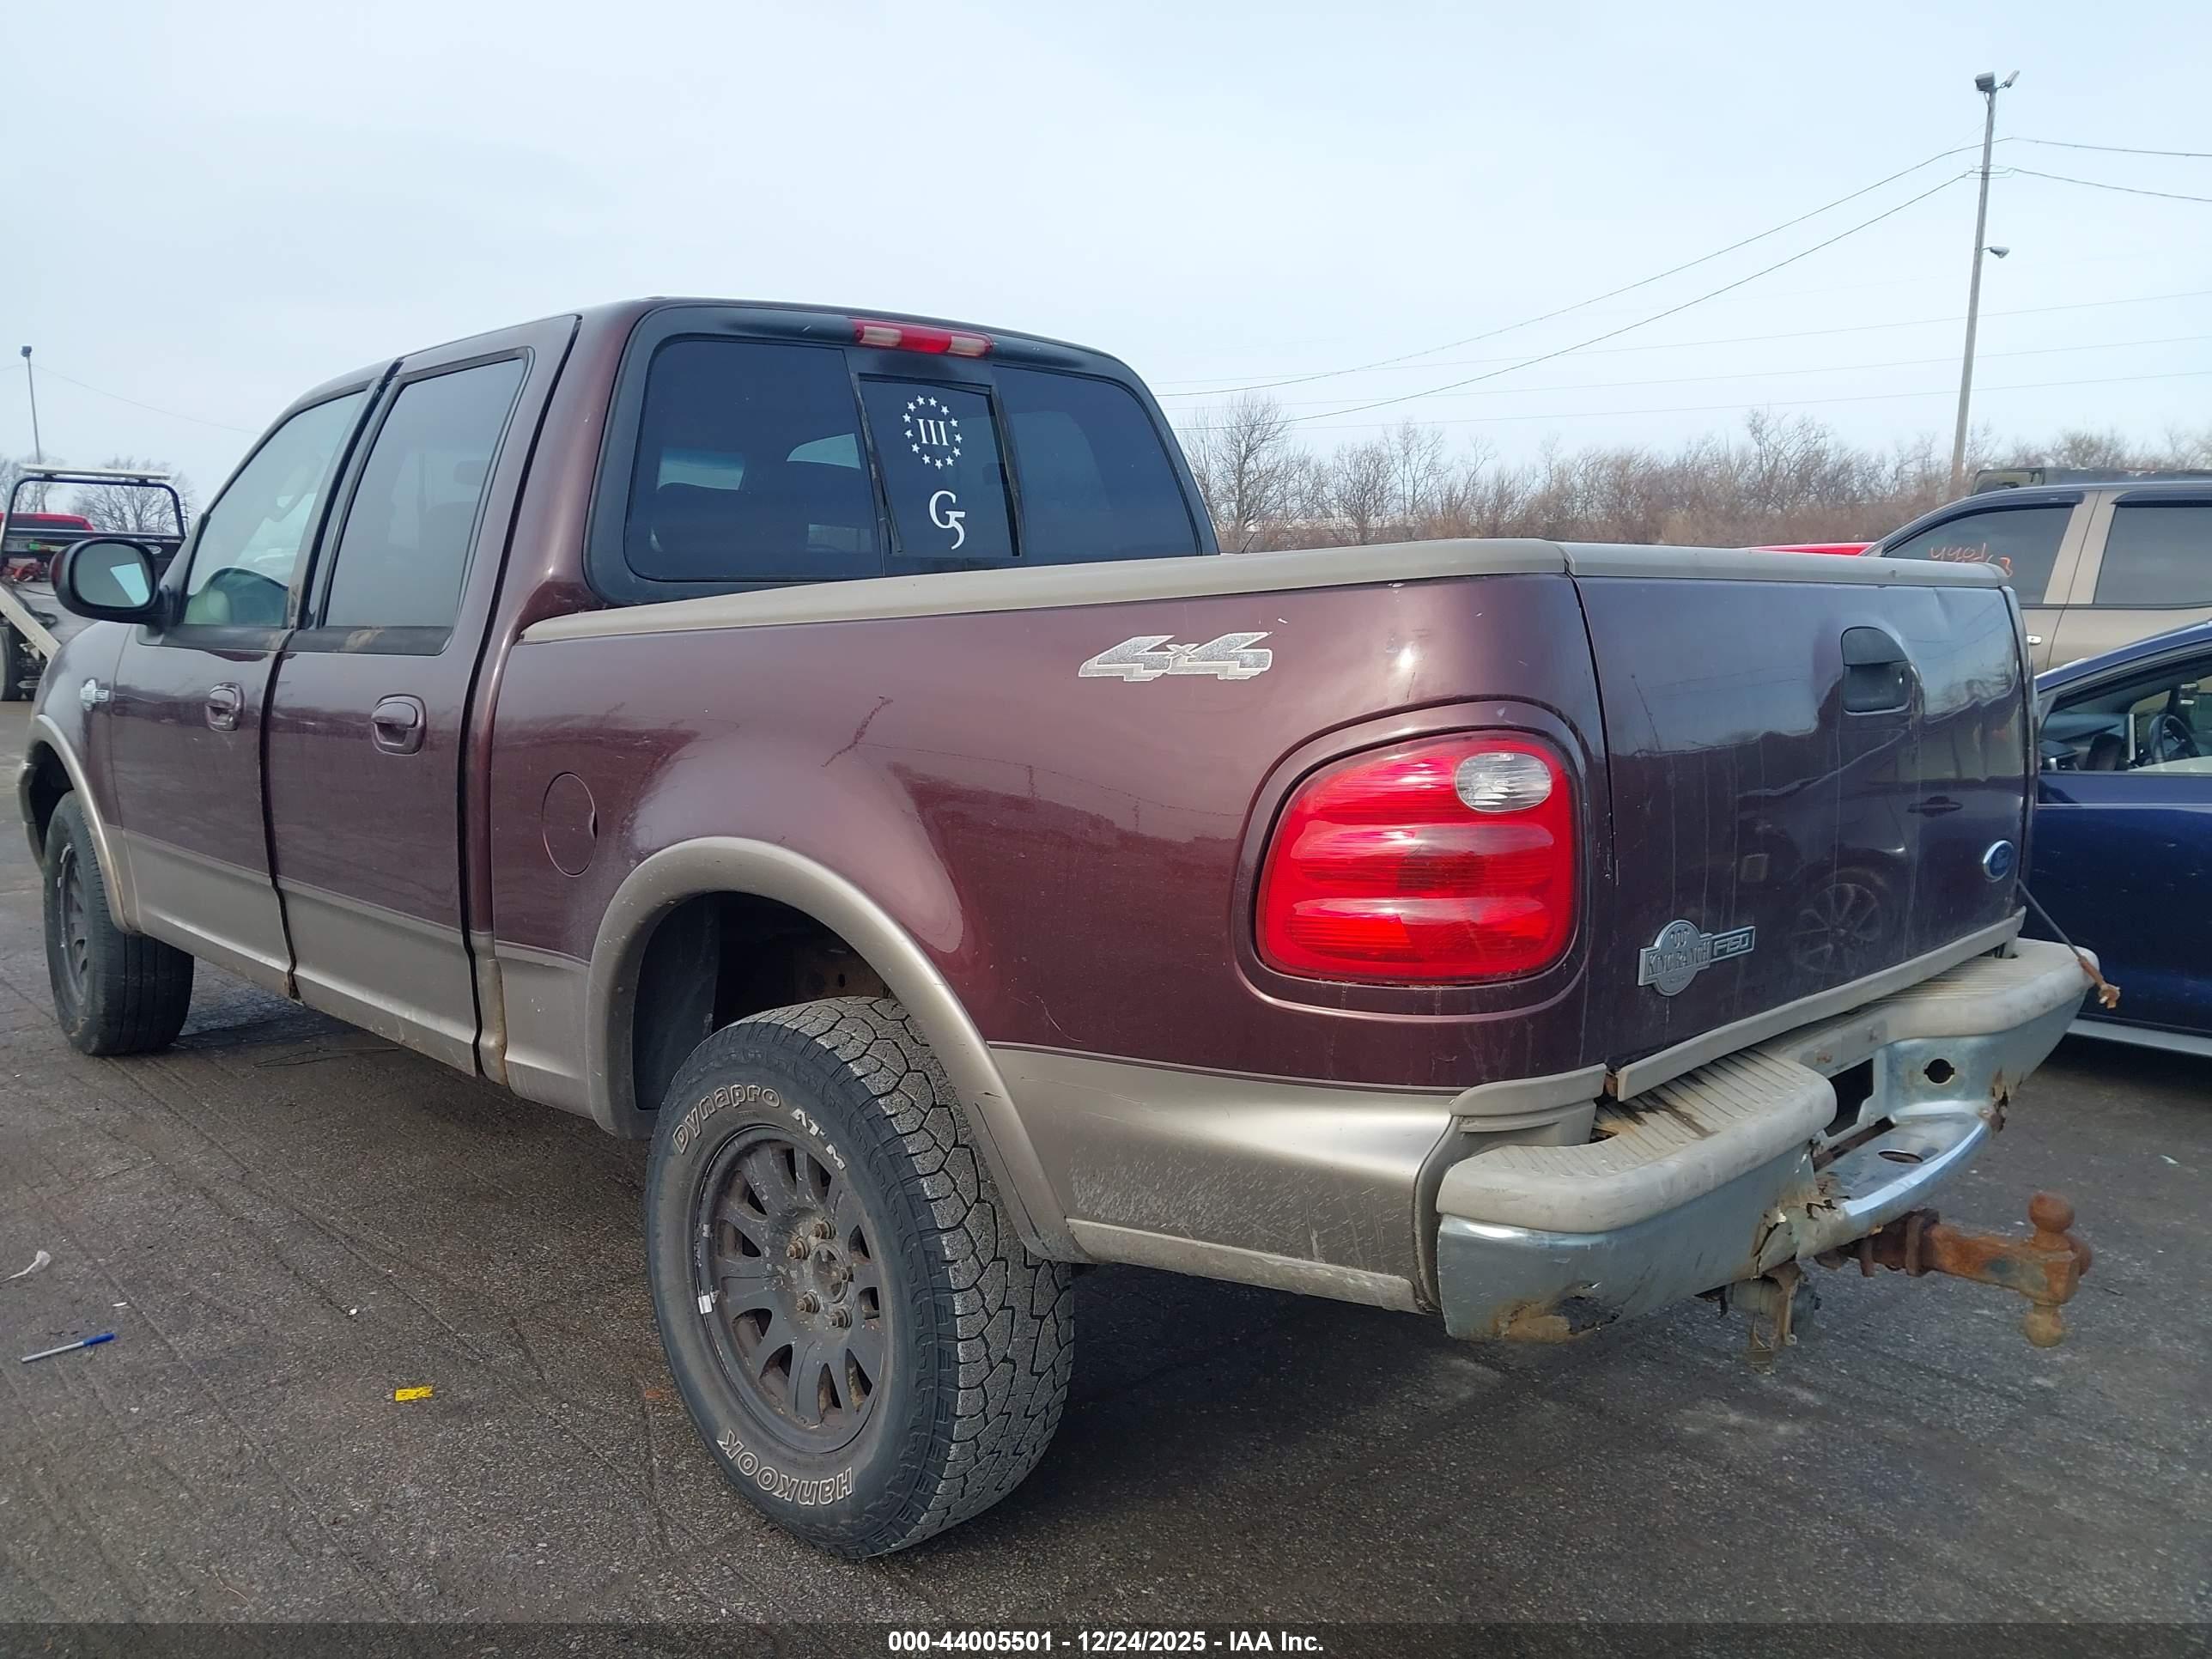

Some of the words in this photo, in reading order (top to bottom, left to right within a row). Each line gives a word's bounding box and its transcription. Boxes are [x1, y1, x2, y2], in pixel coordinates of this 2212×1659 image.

[916, 418, 950, 446] III
[1079, 631, 1273, 682] 4x4
[672, 1084, 781, 1155] Dynapro
